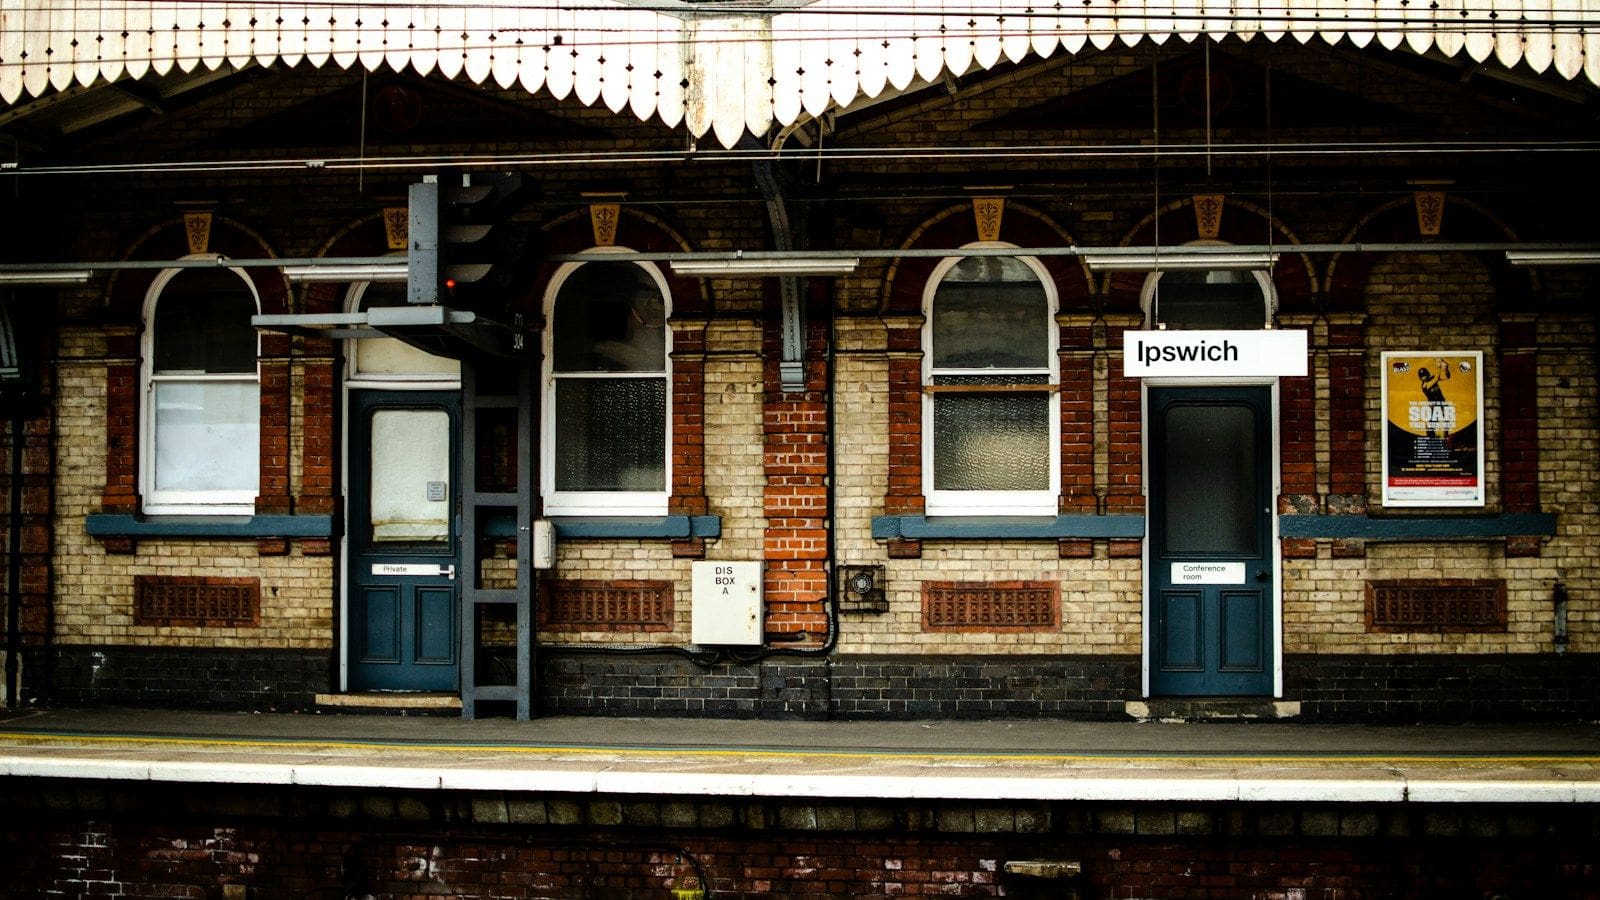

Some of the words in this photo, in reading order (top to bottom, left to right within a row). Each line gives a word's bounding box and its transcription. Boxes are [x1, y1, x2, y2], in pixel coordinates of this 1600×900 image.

[1137, 340, 1239, 367] Ipswich
[1408, 405, 1457, 422] SOAR
[383, 565, 408, 573] Private
[715, 566, 733, 575] DIS
[715, 577, 736, 585] BOX
[722, 587, 729, 595] A
